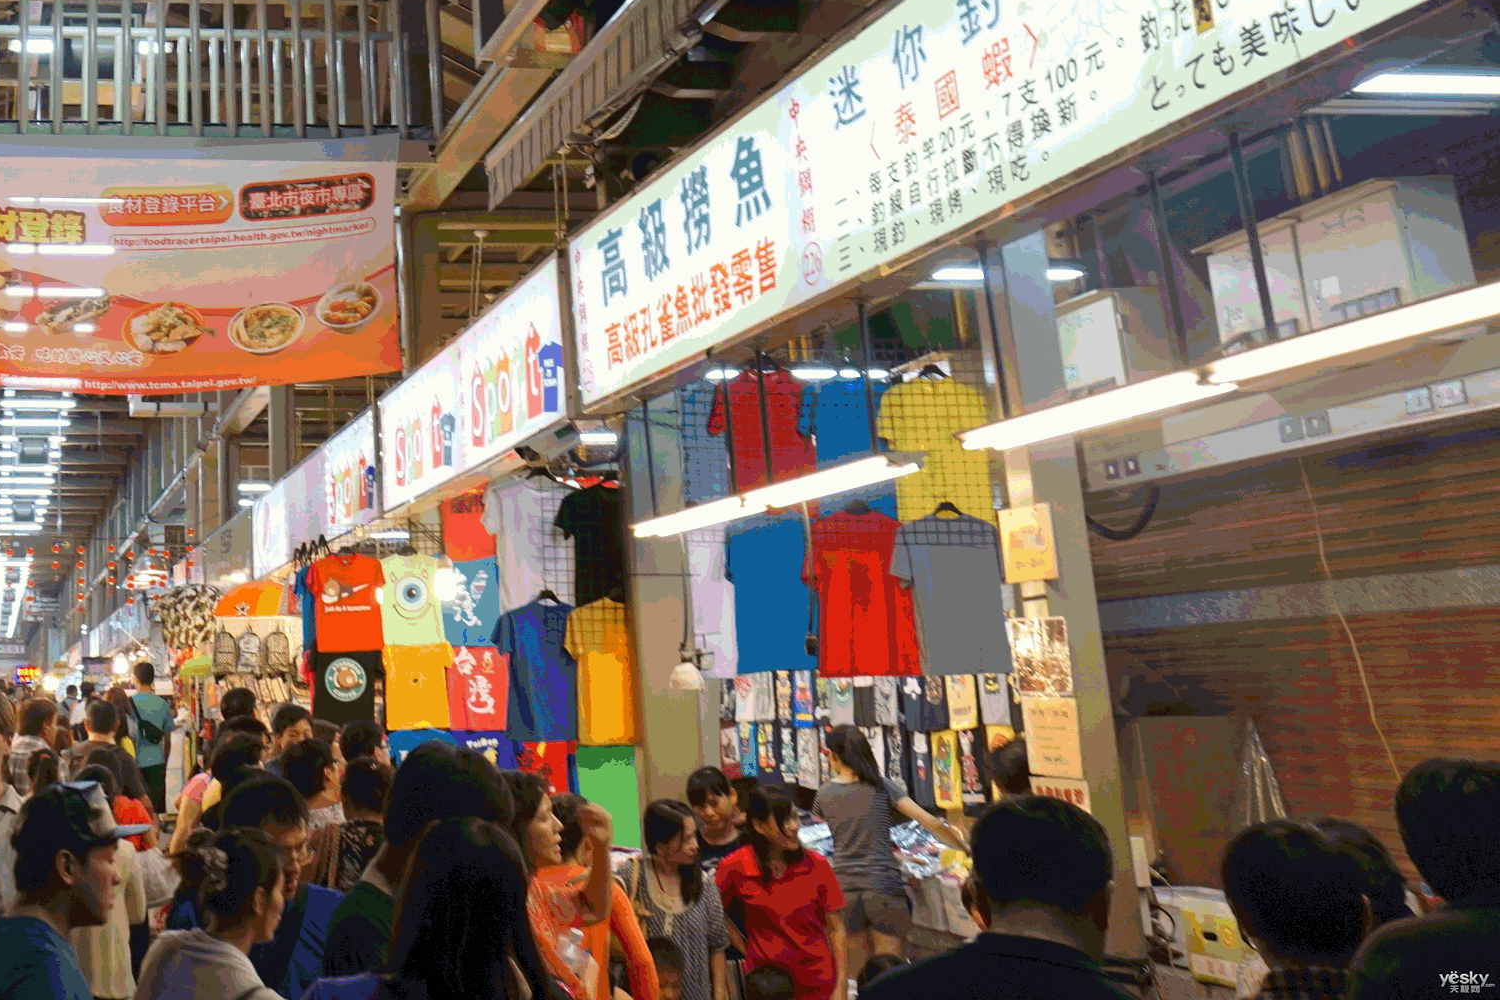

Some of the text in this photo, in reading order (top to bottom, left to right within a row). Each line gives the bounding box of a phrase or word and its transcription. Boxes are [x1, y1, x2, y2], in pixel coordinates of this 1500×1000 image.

[106, 194, 217, 215] 食材登錄平台
[597, 136, 772, 307] 高級撈魚
[604, 236, 778, 370] 高級孔雀魚批發零售
